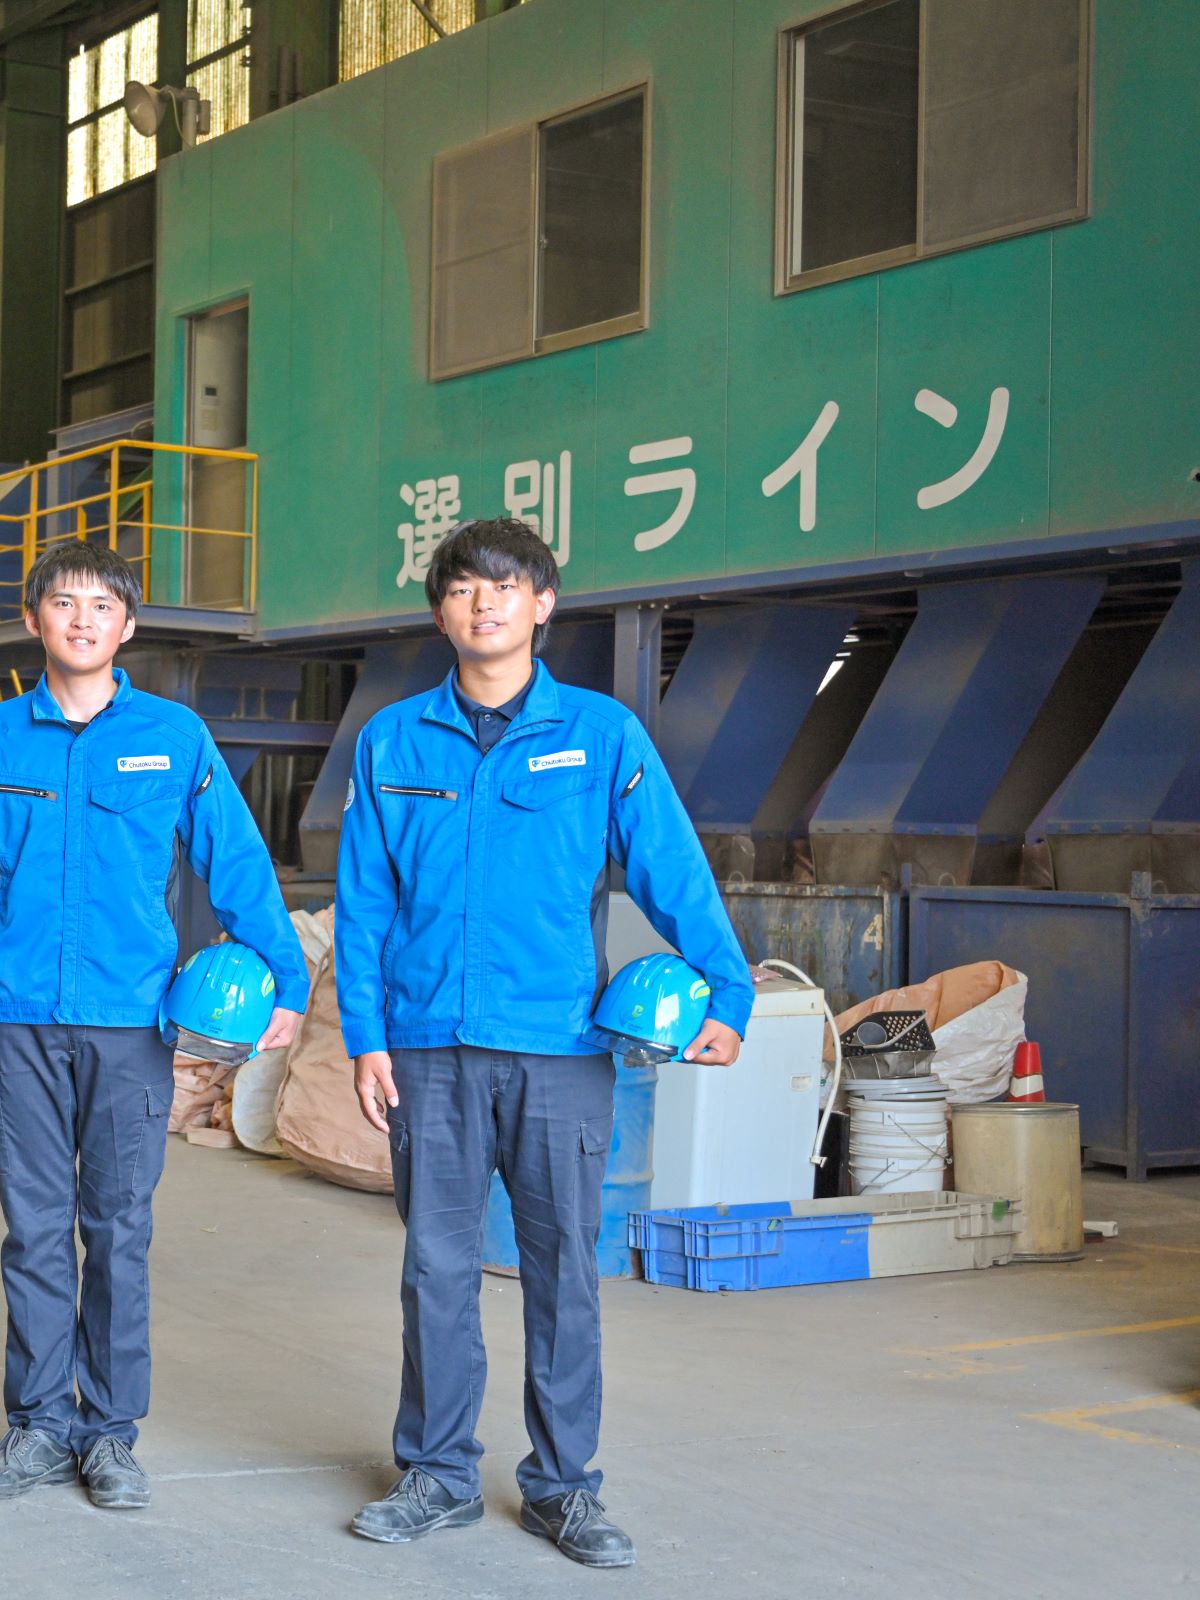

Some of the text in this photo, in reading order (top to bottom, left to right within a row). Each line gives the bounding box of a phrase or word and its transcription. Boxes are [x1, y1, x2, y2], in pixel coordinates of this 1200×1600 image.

[396, 387, 1009, 588] 選別ライン
[863, 914, 883, 951] 4
